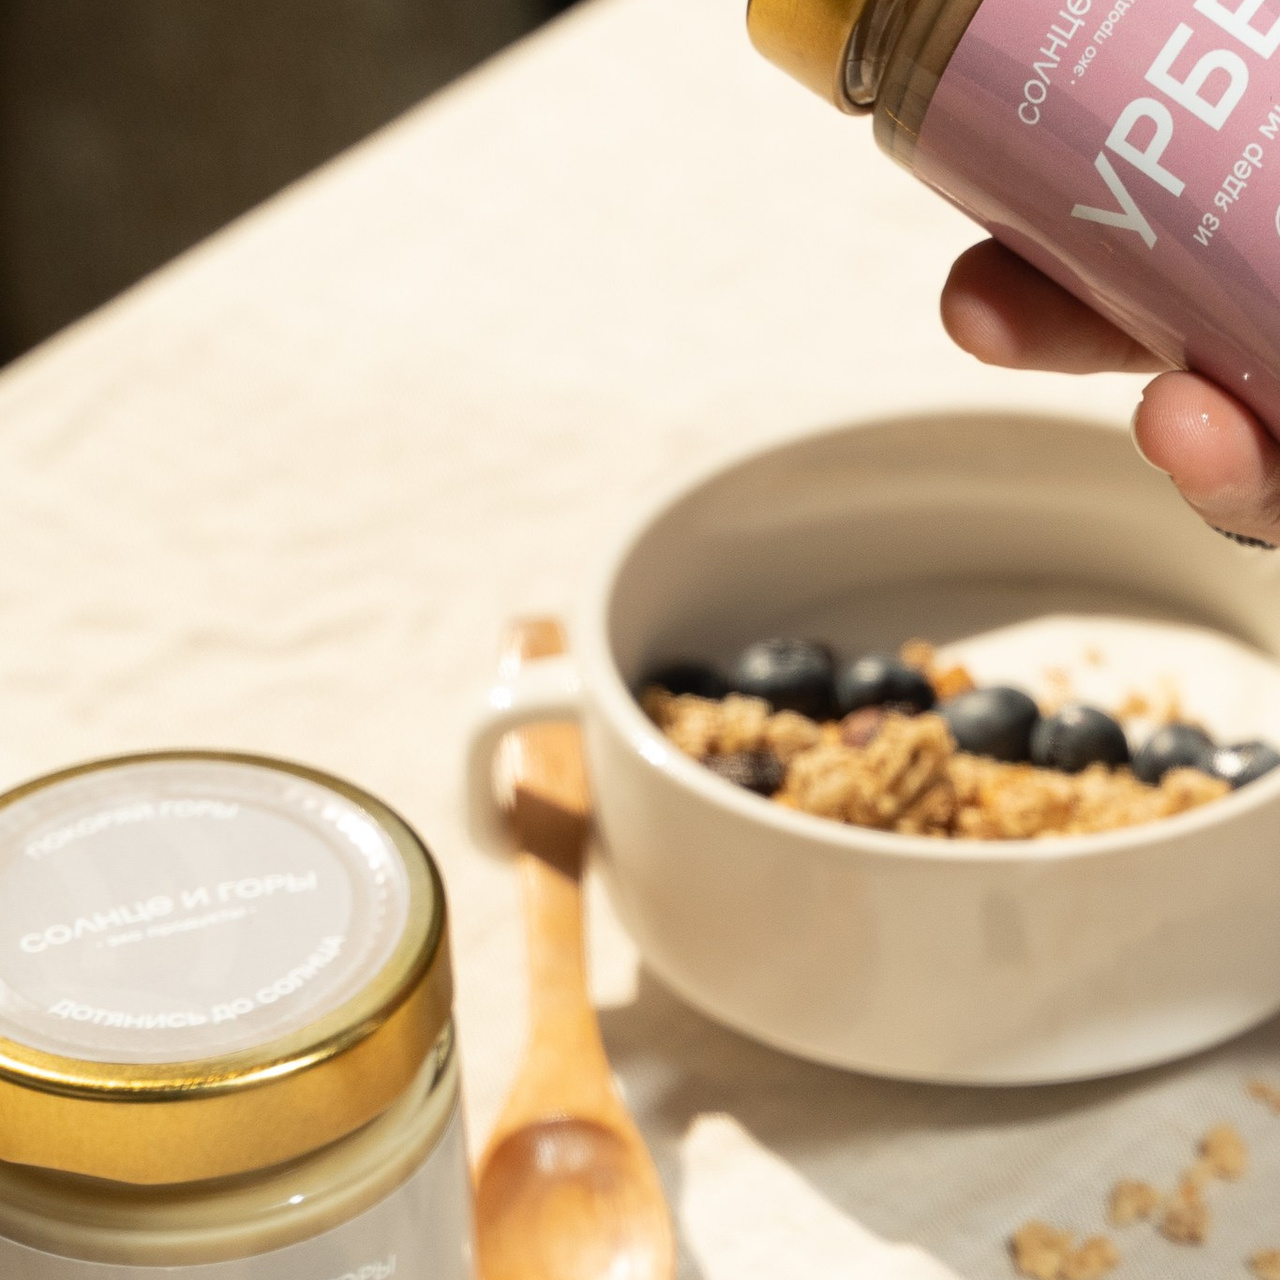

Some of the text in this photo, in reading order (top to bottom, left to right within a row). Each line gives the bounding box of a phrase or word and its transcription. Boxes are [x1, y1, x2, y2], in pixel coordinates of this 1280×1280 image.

[1073, 46, 1097, 77] эко
[1193, 212, 1220, 247] из
[1213, 142, 1264, 213] ядер
[179, 886, 211, 909] И
[217, 870, 318, 903] ГОРЫ
[48, 998, 207, 1030] ДОТЯНИСЬ
[211, 997, 254, 1024] ДО
